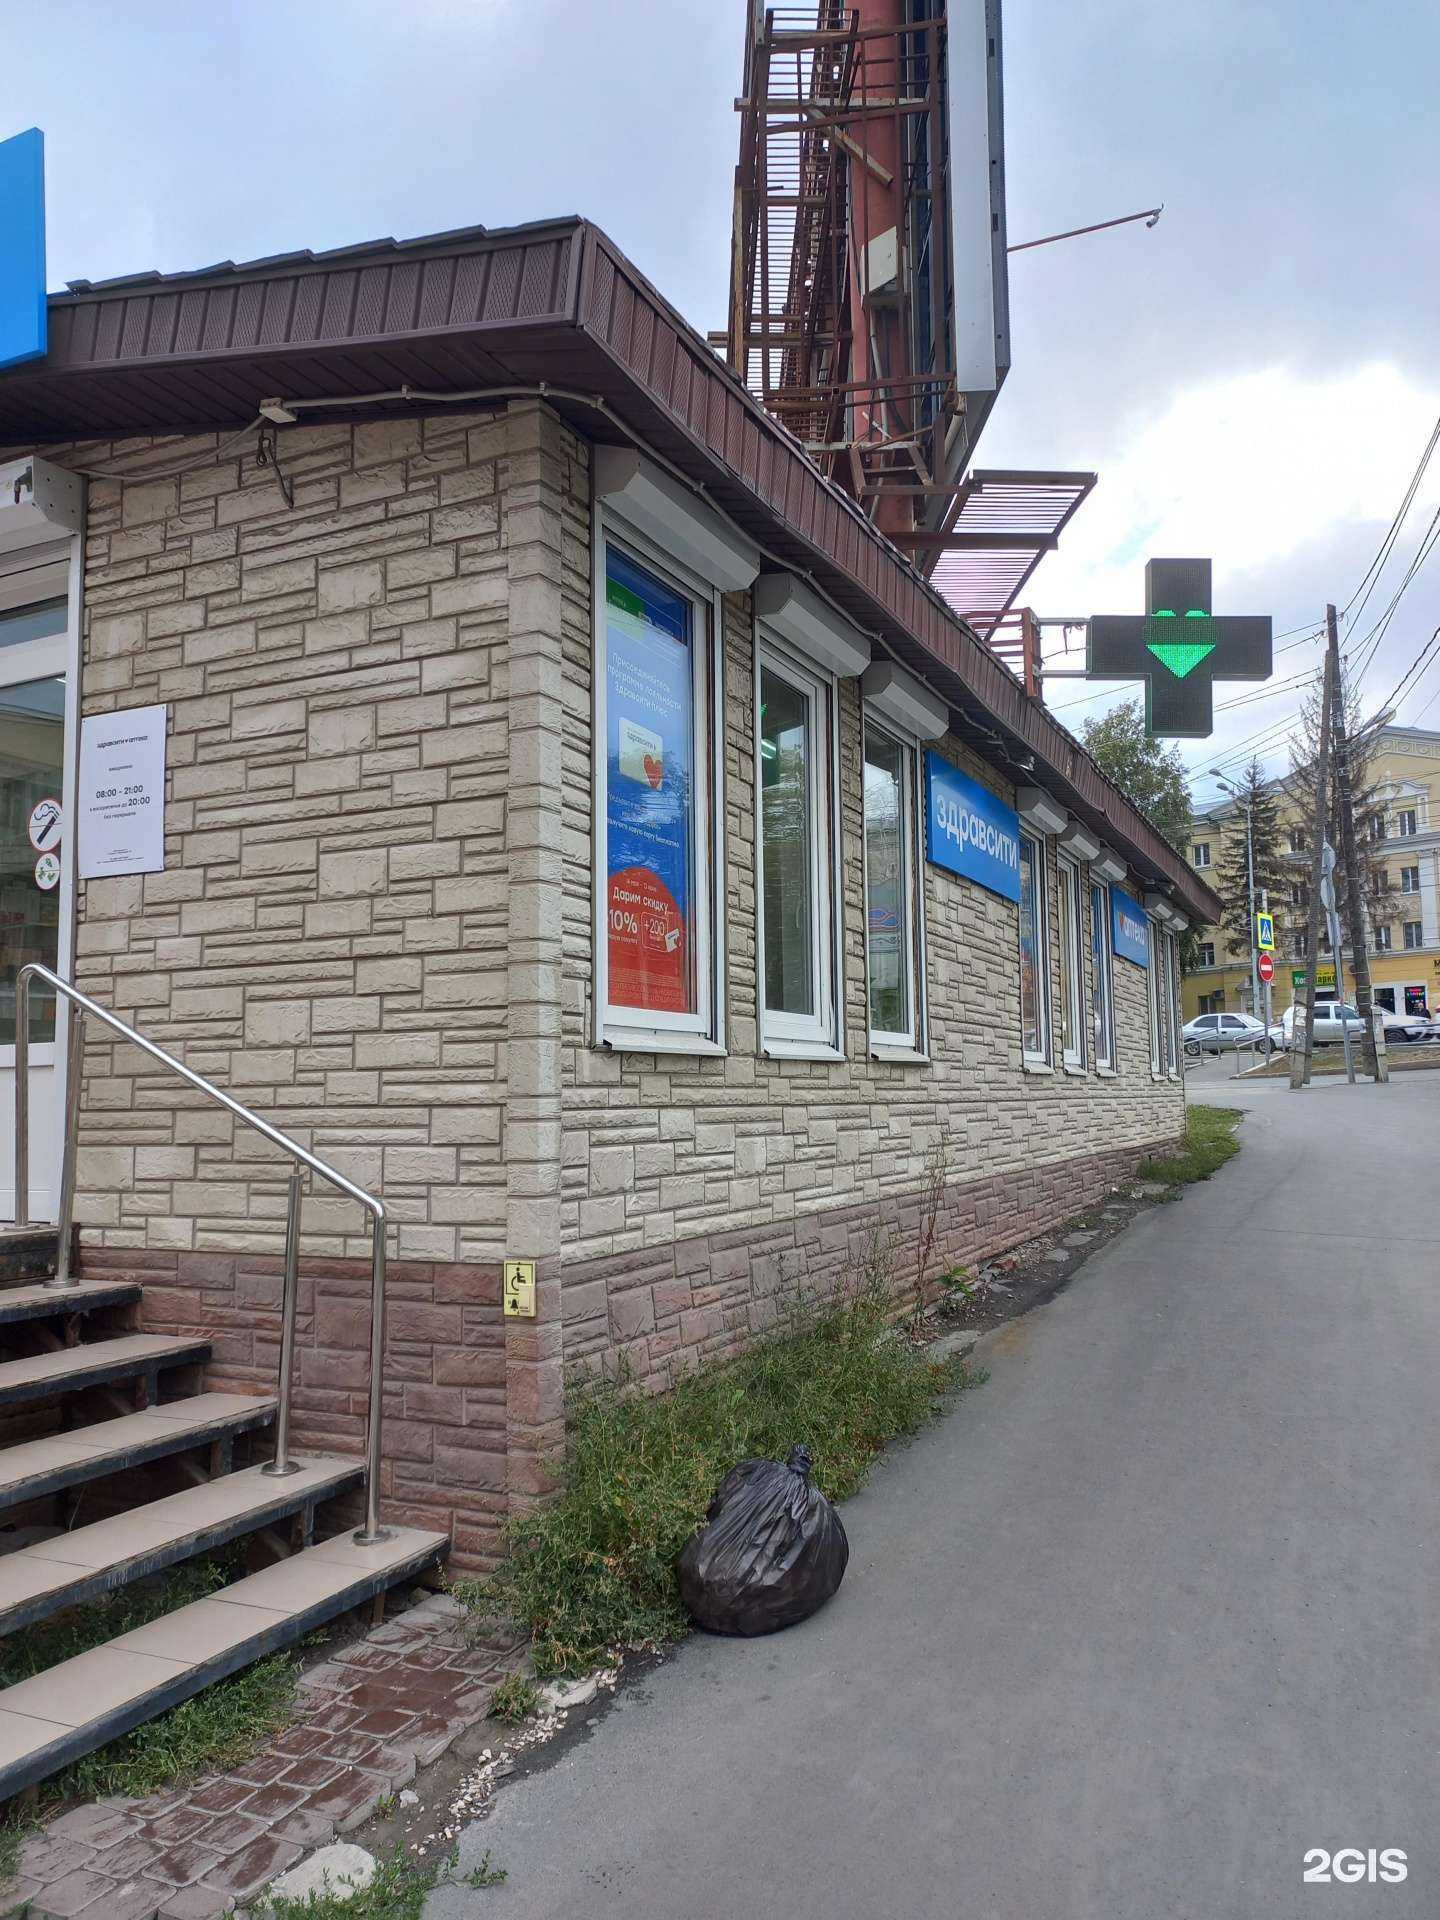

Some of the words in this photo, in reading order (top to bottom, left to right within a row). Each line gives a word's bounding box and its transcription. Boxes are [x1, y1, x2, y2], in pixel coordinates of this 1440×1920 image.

[96, 789, 117, 798] 08:00
[123, 785, 143, 794] 21:00
[128, 796, 150, 806] 20:00
[937, 795, 1017, 869] здравсити
[613, 886, 641, 905] Дарим
[643, 896, 669, 916] скидку
[609, 908, 638, 934] 10%
[643, 918, 665, 937] +200
